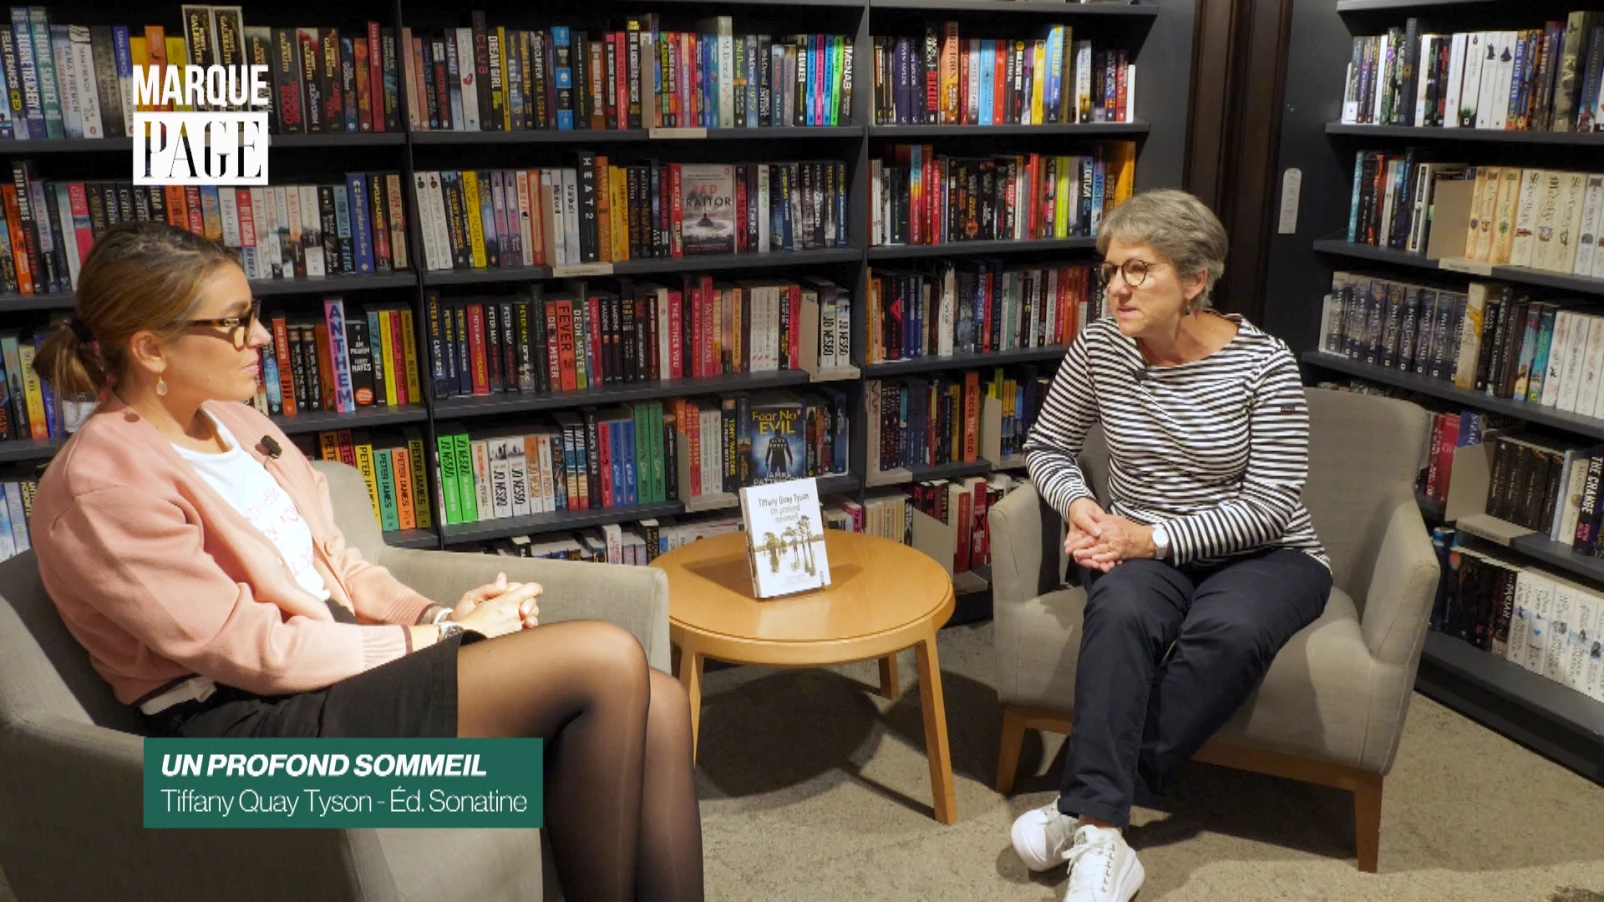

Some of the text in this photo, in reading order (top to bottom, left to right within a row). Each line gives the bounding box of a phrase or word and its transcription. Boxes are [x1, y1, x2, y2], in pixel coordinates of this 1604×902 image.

[1, 31, 18, 88] FELIX FRANCIS
[17, 34, 29, 64] BOURNE
[35, 34, 49, 64] BOURNE
[476, 34, 488, 75] CLUB
[488, 36, 501, 89] DREAM GIRL
[64, 46, 80, 112] TANA FRENCH
[281, 86, 293, 124] BLOOD
[186, 187, 198, 208] John
[583, 157, 594, 206] HEAT
[692, 184, 718, 194] RED
[682, 196, 731, 208] RAITOR
[430, 296, 438, 320] PETER
[444, 310, 452, 329] PETER
[559, 305, 572, 351] FEVER
[574, 310, 585, 374] DEON MEYER
[823, 317, 834, 355] JO NESBO
[839, 332, 848, 356] NESBO
[328, 305, 354, 405] ANTHEM
[550, 347, 559, 378] MEYER
[752, 410, 797, 421] Fear No
[760, 420, 796, 434] EVIL
[325, 435, 336, 461] PETE
[359, 446, 371, 477] PETER
[440, 441, 455, 478] JO NESBO
[457, 438, 470, 475] JO NESBO
[379, 454, 392, 508] PETER JAMES
[397, 452, 409, 507] PETER JAMES
[412, 442, 426, 505] PETER JAMES
[494, 471, 507, 506] JO NESBO
[512, 469, 526, 504] JO NESBO
[529, 476, 540, 498] NESBO
[1582, 456, 1603, 515] THE CHANGE
[758, 493, 810, 508] Tiffany Quay Tyson
[770, 508, 779, 516] Un
